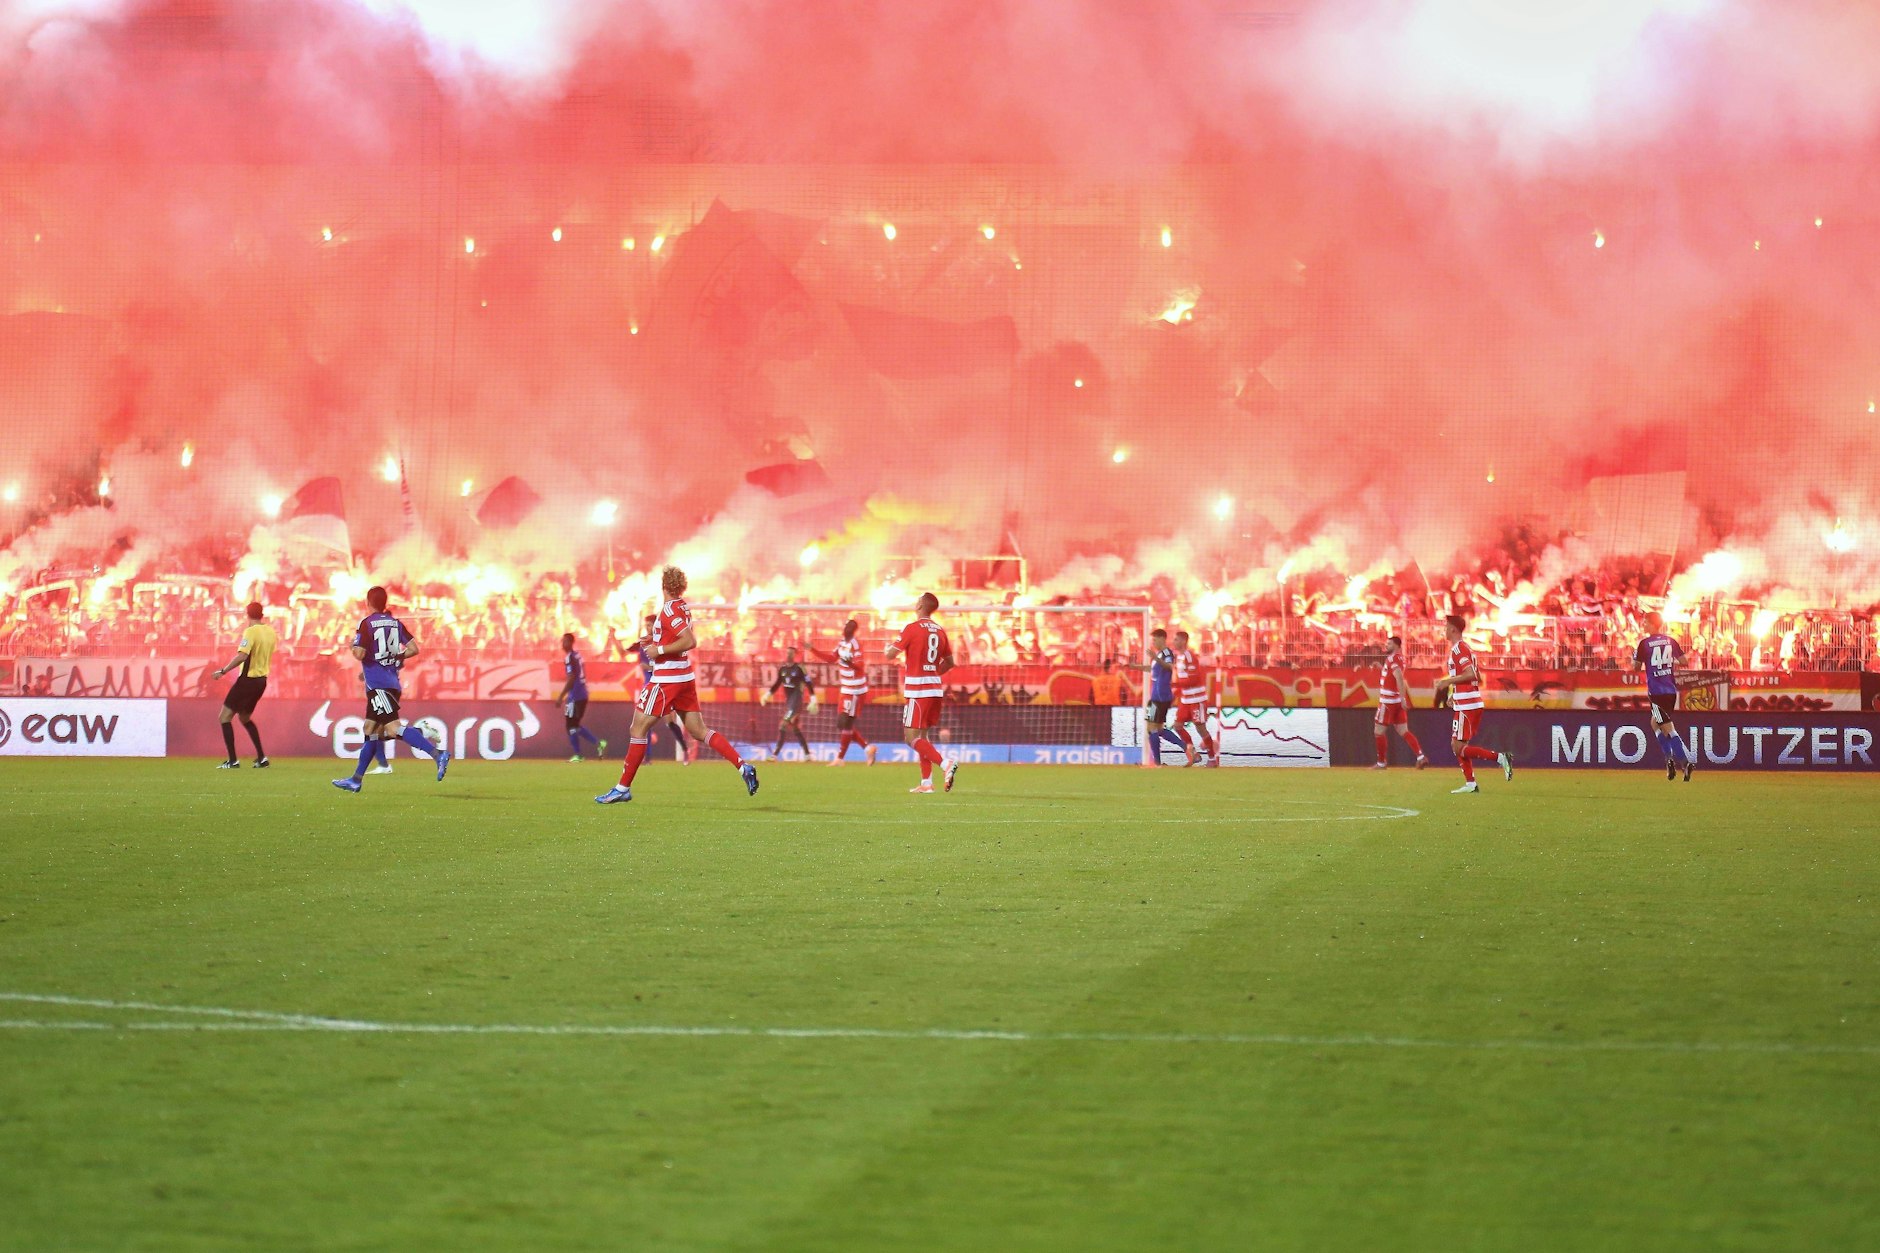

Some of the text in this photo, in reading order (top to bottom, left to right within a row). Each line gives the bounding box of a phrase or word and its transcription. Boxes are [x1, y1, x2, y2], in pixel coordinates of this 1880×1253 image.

[373, 626, 400, 660] 14
[927, 633, 940, 664] 8
[1651, 645, 1673, 669] 44
[371, 696, 384, 711] 14
[20, 712, 120, 744] eaw
[912, 745, 981, 764] isin
[1055, 745, 1125, 765] raisin
[1551, 725, 1647, 764] MIO
